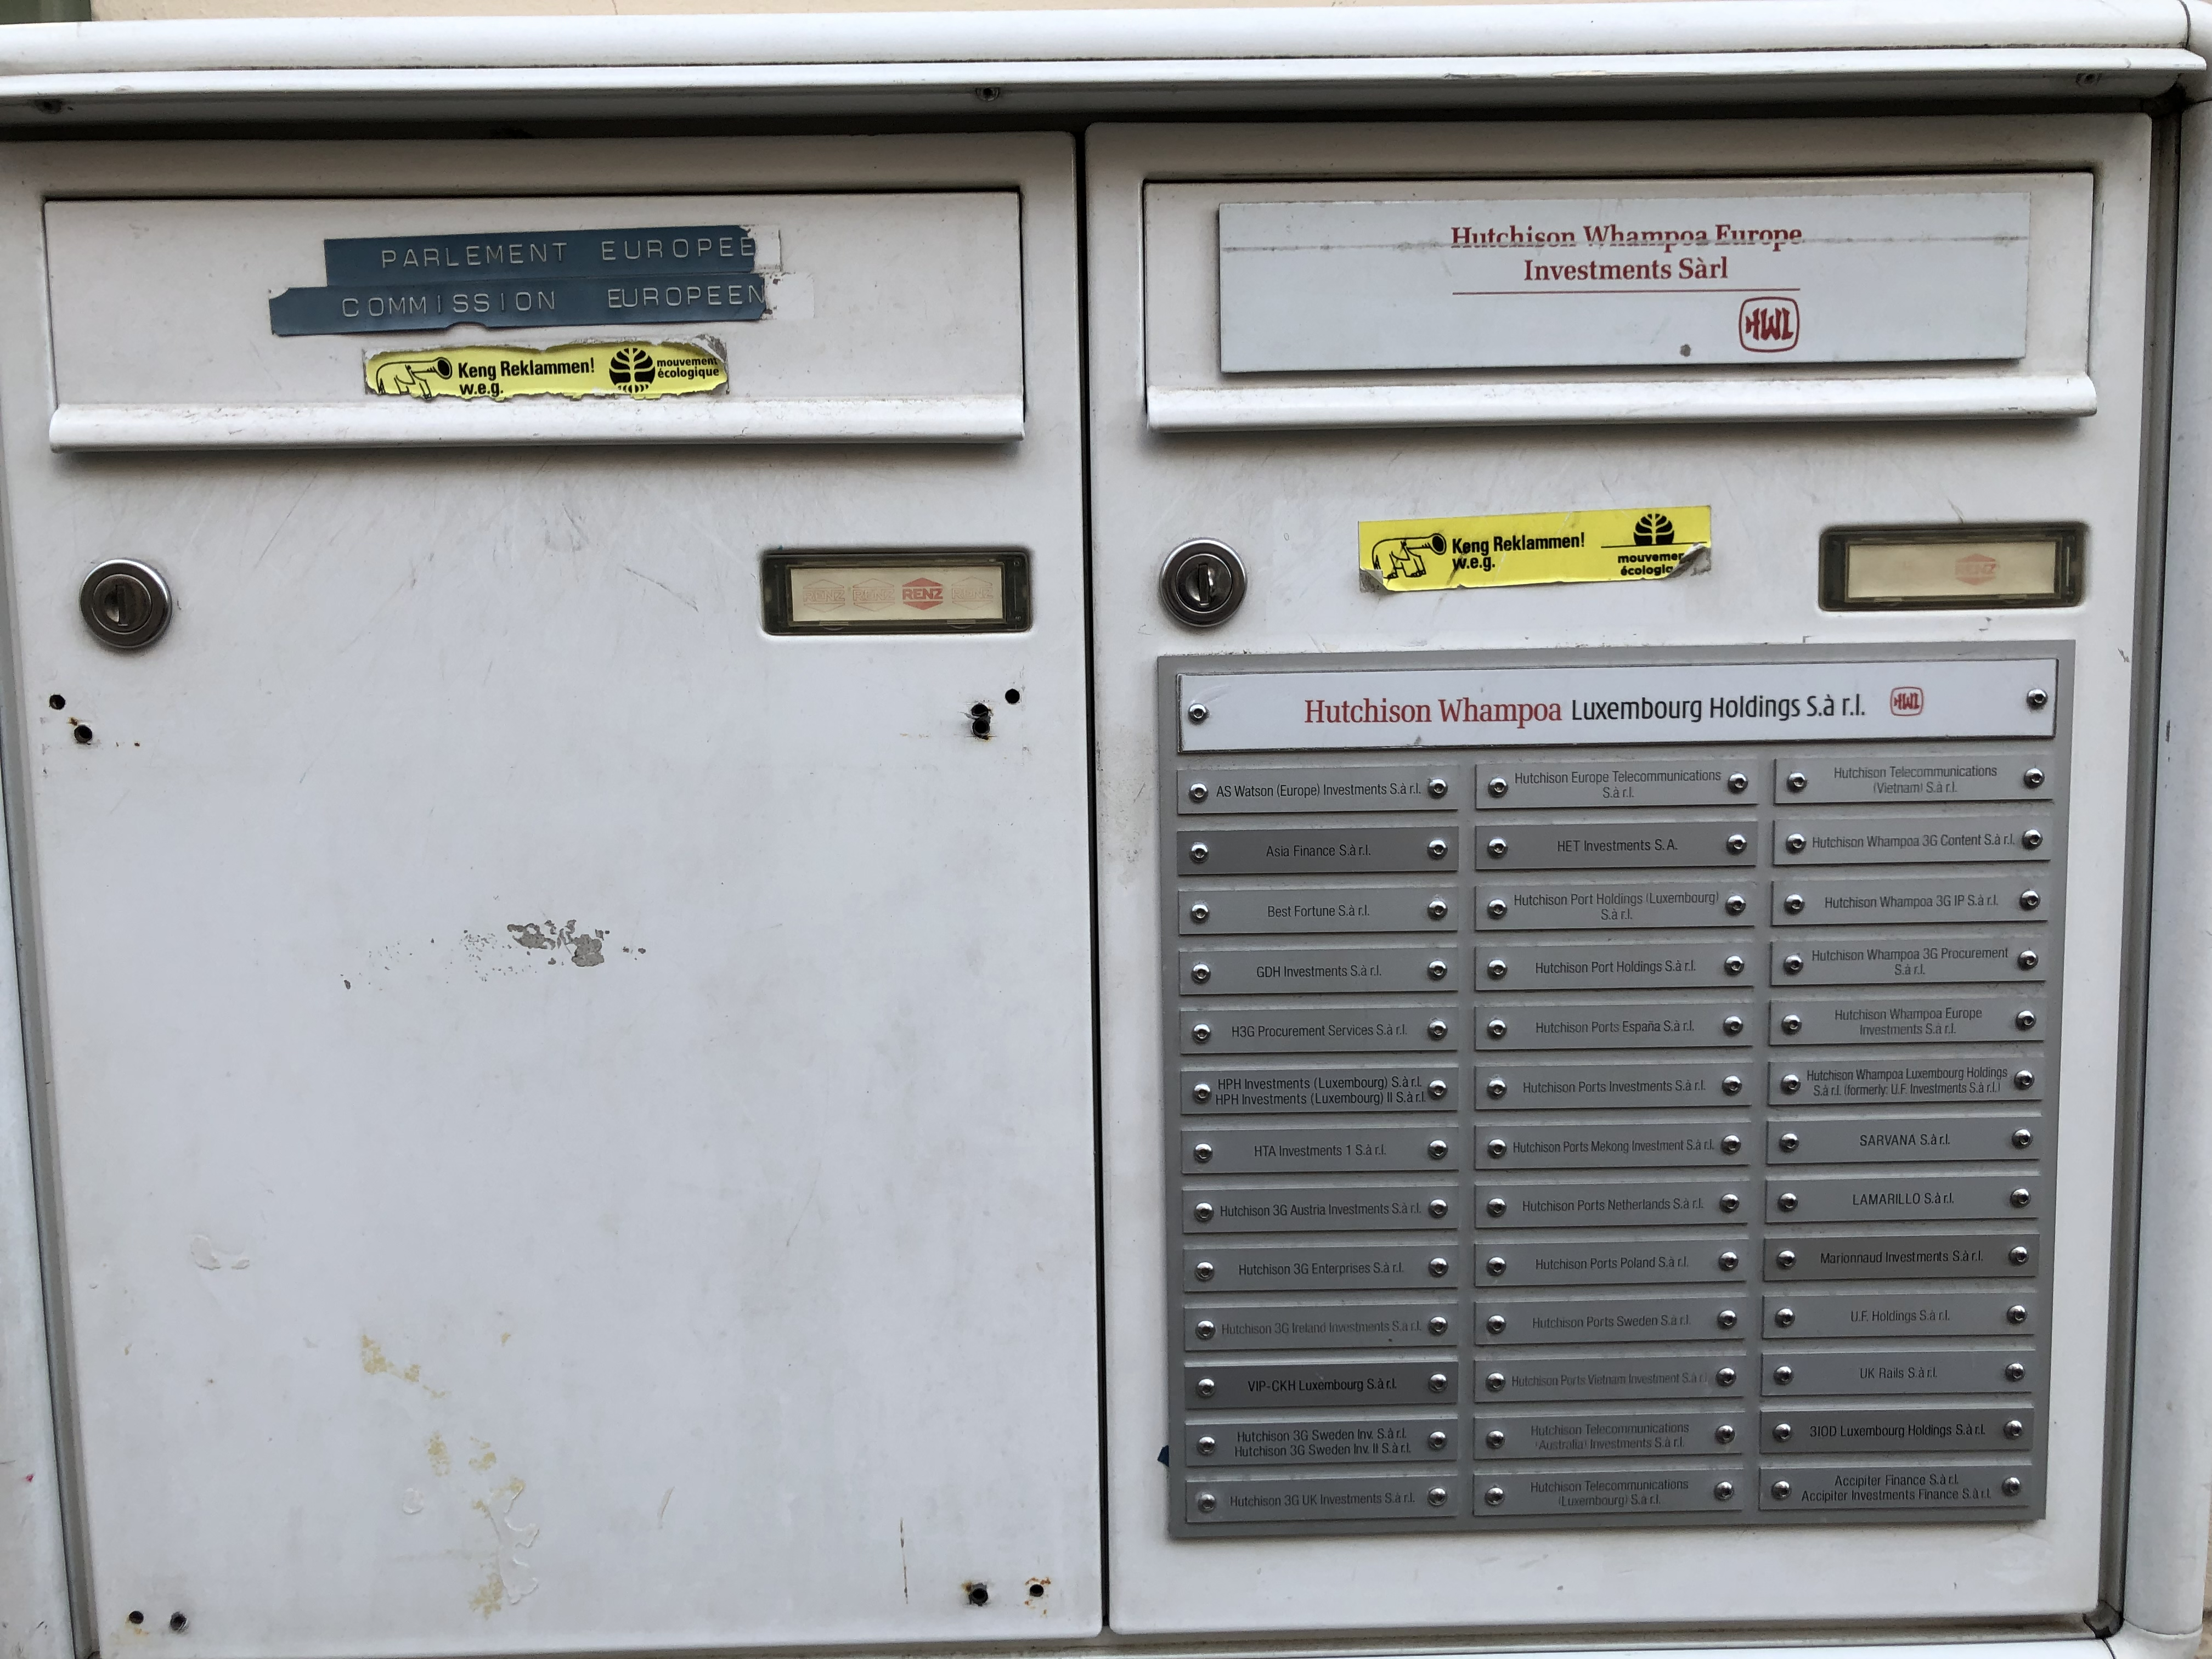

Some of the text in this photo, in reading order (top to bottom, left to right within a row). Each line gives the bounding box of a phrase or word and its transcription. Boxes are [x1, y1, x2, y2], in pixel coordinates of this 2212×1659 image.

[1451, 224, 1804, 252] Hutchison Whampoa Europe
[382, 236, 755, 268] PARLEMENT EUROPEE
[1525, 256, 1727, 280] Investments Sàrl
[342, 285, 765, 317] COMMISSION EUROPEEN
[459, 357, 594, 381] Keng Reklammen!
[657, 365, 719, 379] écologique
[458, 383, 503, 397] w.e.g.
[1453, 532, 1584, 556] Keng Reklammen!
[1452, 552, 1495, 573] w.e.g.
[902, 588, 943, 600] RENZ
[1305, 693, 1865, 726] Hutchison Whampoa Luxembourg Holdings S.à r.l.
[1515, 770, 1721, 785] Hutchison Europe Telecommunications
[1216, 786, 1231, 797] AS
[1234, 786, 1273, 797] Watson
[1277, 784, 1319, 798] (Europe)
[1324, 784, 1386, 795] Investments
[1558, 840, 1579, 851] HET
[1584, 840, 1650, 851] Investments
[1813, 837, 1863, 848] Hutchison
[1867, 836, 1919, 849] Whampoa
[1922, 835, 1937, 846] 3G
[1941, 834, 1980, 845] Content
[1267, 846, 1289, 856] Asia
[1294, 845, 1335, 856] Finance
[1515, 892, 1718, 906] Hutchison Port Holdings (Luxembourg)
[1825, 895, 1964, 909] Hutchison Whampoa 3G IP
[1268, 906, 1291, 917] Best
[1295, 906, 1335, 916] Fortune
[1813, 948, 2007, 962] Hutchison Whampoa 3G Procurement
[1257, 966, 1280, 977] GDH
[1284, 966, 1347, 977] Investments
[1536, 962, 1588, 973] Hutchison
[1592, 962, 1613, 972] Port
[1617, 961, 1661, 974] Holdings
[1232, 1026, 1254, 1037] H3G
[1259, 1026, 1325, 1036] Procurement
[1329, 1025, 1373, 1036] Services
[1537, 1022, 1588, 1033] Hutchison
[1592, 1022, 1619, 1032] Ports
[1623, 1021, 1661, 1034] España
[1218, 1079, 1241, 1090] HPH
[1245, 1079, 1310, 1089] Investments
[1314, 1077, 1387, 1090] (Luxembourg)
[1523, 1081, 1672, 1093] Hutchison Ports Investments
[1216, 1094, 1238, 1105] HPH
[1243, 1093, 1306, 1104] Investments
[1311, 1092, 1383, 1105] (Luxembourg)
[1860, 1135, 1916, 1146] SARVANA
[1255, 1146, 1276, 1156] HTA
[1279, 1146, 1342, 1156] Investments
[1514, 1141, 1683, 1153] Hutchison Ports Mekong Investment
[1523, 1199, 1670, 1211] Hutchison Ports Netherlands
[1853, 1193, 1920, 1205] LAMARILLO
[1221, 1204, 1389, 1216] Hutchison 3G Austria Investments
[1536, 1257, 1655, 1269] Hutchison Ports Poland
[1821, 1252, 1882, 1263] Marionnaud
[1886, 1251, 1948, 1262] Investments
[1239, 1263, 1370, 1275] Hutchison 3G Enterprises
[1872, 1311, 1916, 1322] Holdings
[1861, 1368, 1904, 1378] UK Rails
[1248, 1380, 1363, 1392] VIP-CKH Luxembourg
[1841, 1426, 1904, 1437] Luxembourg
[1909, 1425, 1951, 1437] Holdings
[1835, 1475, 1925, 1487] Accipiter Finance
